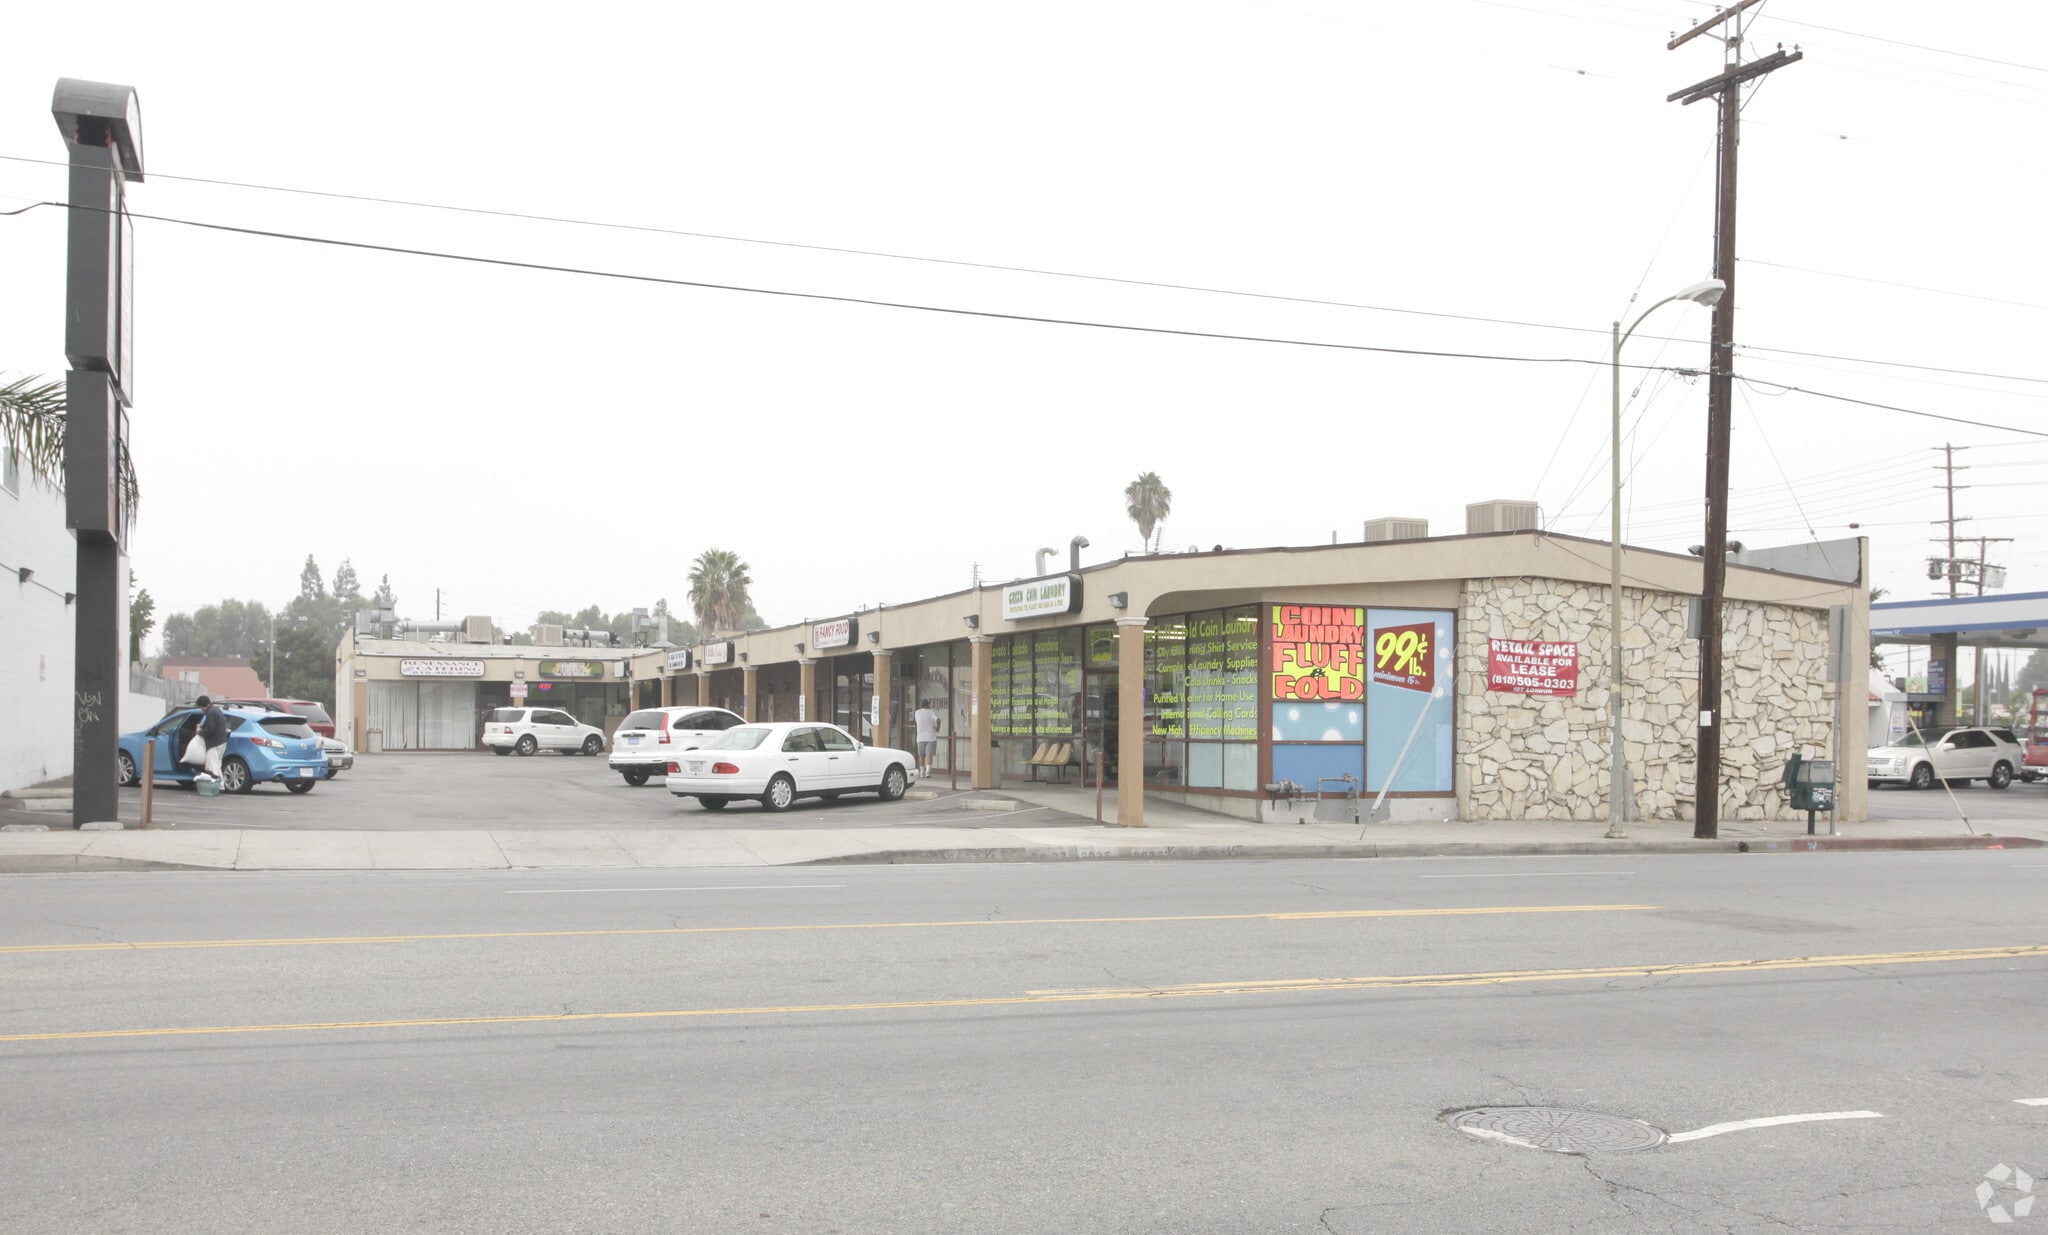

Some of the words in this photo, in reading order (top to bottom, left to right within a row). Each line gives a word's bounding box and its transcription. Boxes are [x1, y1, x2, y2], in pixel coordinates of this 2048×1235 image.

[1009, 590, 1023, 605] GREEN
[1026, 587, 1038, 602] COIN
[1040, 583, 1066, 600] LAUNDRY
[1280, 606, 1354, 625] COIN
[820, 625, 834, 638] FANCY
[836, 622, 848, 636] FOOD
[1200, 619, 1218, 637] Coin
[1221, 616, 1257, 635] Laundry
[1272, 624, 1364, 643] LAUNDRY
[1227, 640, 1257, 652] Service
[1492, 639, 1535, 655] RETAIL
[1538, 644, 1576, 657] SPACE
[1194, 659, 1223, 671] Laundry
[1272, 643, 1363, 676] FLUFF
[1496, 654, 1549, 666] AVAILABLE
[1552, 658, 1572, 666] FOR
[1374, 671, 1406, 683] minimum
[1511, 664, 1557, 677] LEASE
[1185, 676, 1200, 687] Cold
[1204, 674, 1225, 686] Drinks
[1232, 673, 1257, 685] Snacks
[1275, 675, 1364, 699] FOLD
[1492, 674, 1575, 689] (818)505-0303
[1153, 692, 1178, 704] Purified
[1204, 691, 1214, 702] for
[1216, 691, 1237, 702] Home
[1240, 690, 1254, 701] Use
[1161, 708, 1206, 719] Internaional
[1207, 707, 1233, 720] Calling
[1152, 724, 1167, 735] New
[1168, 724, 1182, 737] High
[1189, 723, 1221, 737] Efficiency
[1223, 724, 1258, 737] Machines
